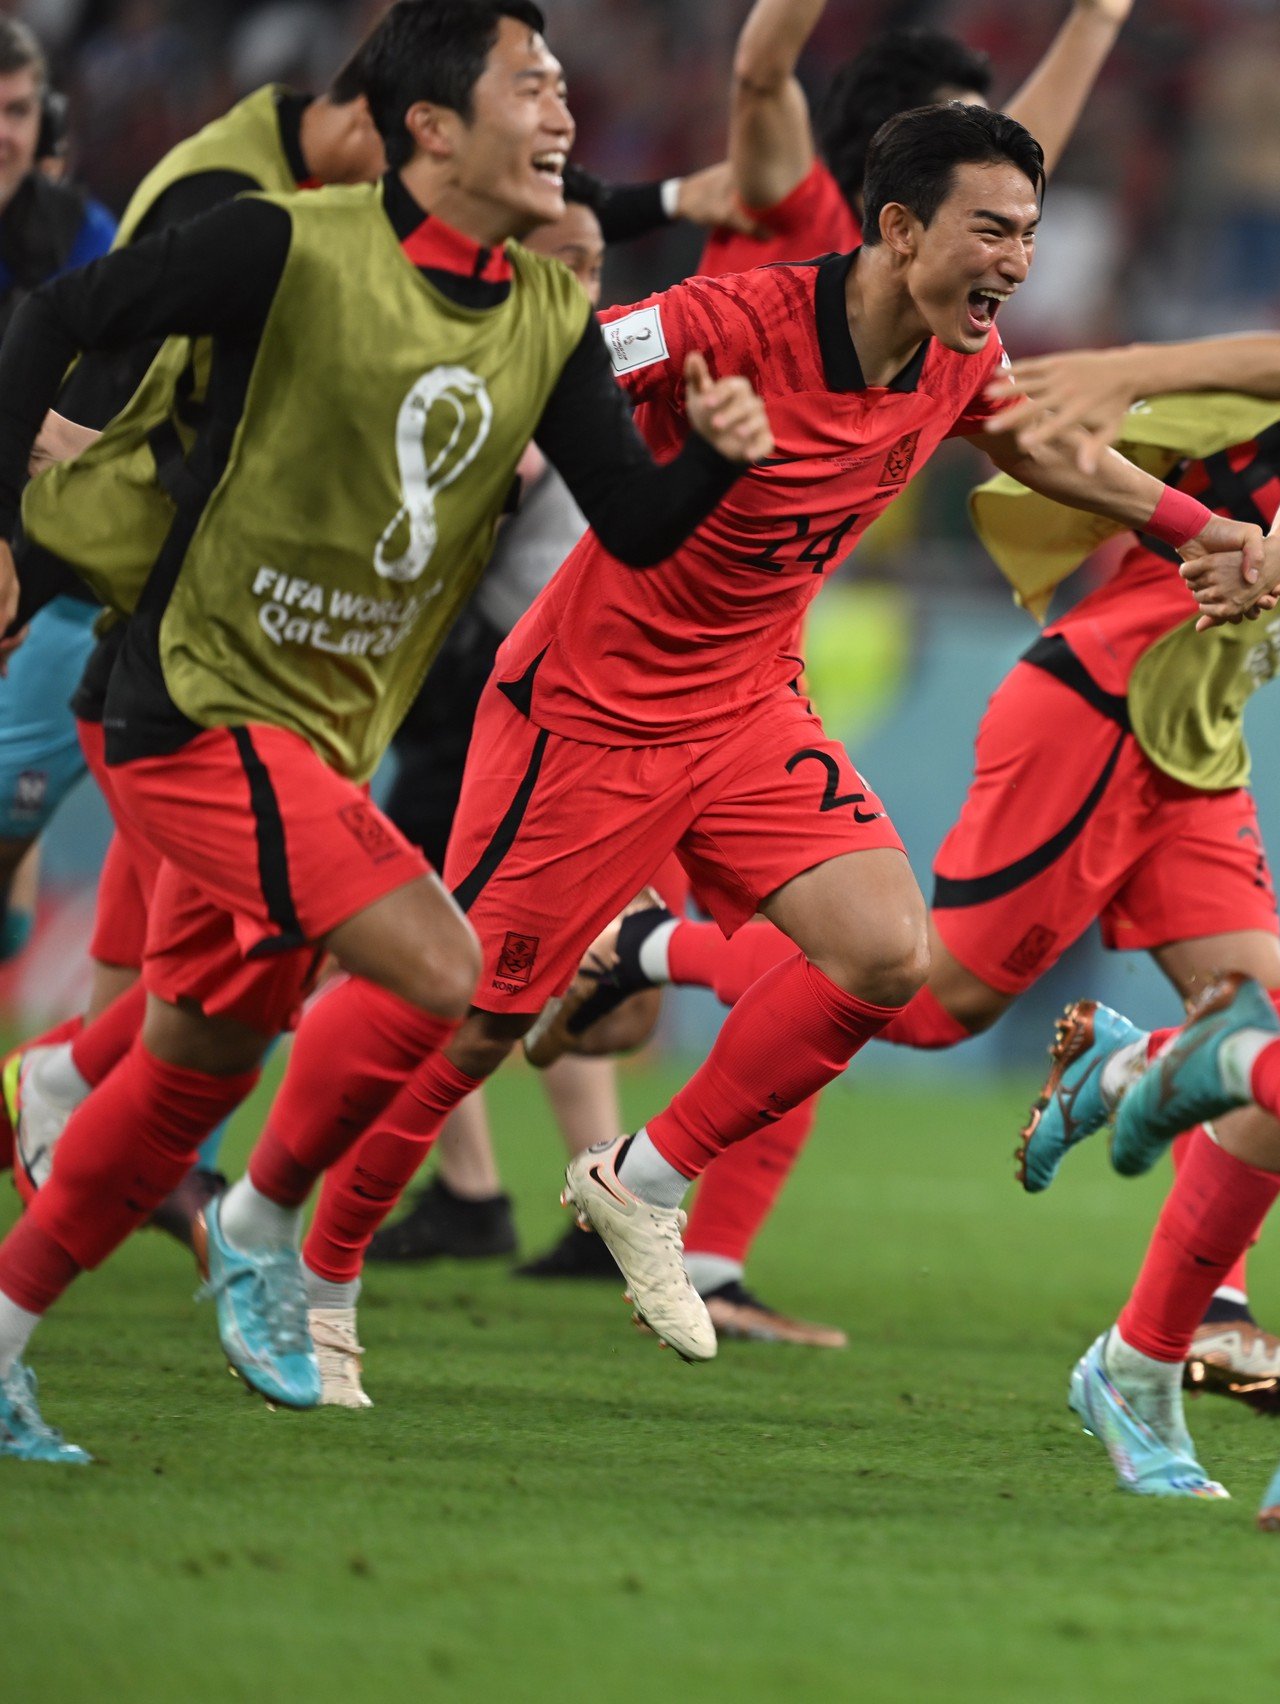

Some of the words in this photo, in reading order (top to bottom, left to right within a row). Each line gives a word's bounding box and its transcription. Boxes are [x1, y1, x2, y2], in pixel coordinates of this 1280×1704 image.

[739, 514, 860, 575] 24
[253, 566, 324, 614] FIFA
[785, 750, 869, 812] 2
[492, 979, 527, 995] KORE
